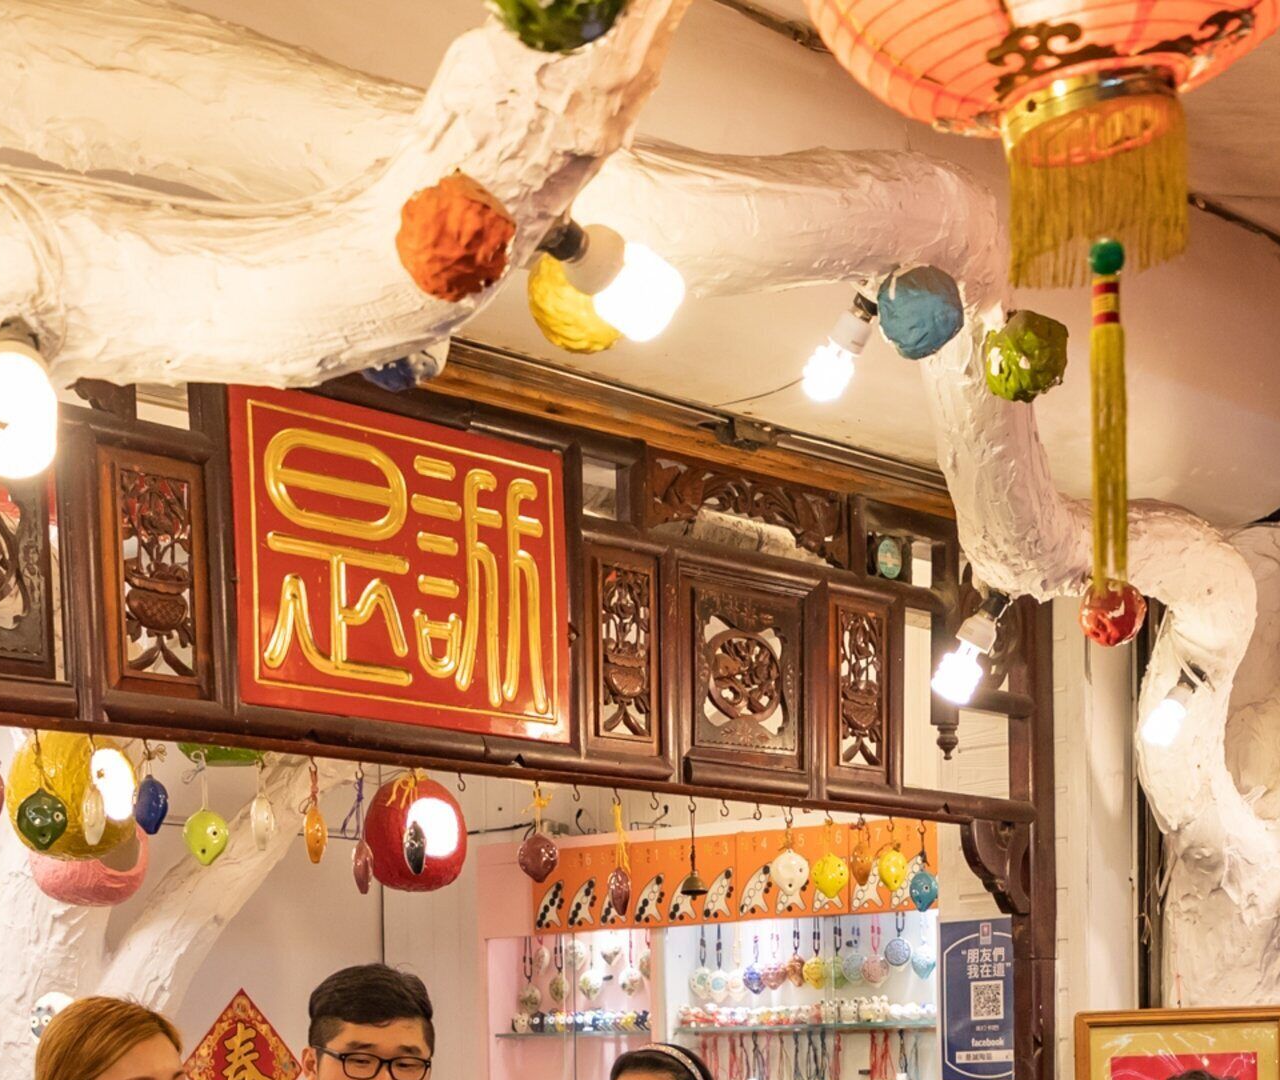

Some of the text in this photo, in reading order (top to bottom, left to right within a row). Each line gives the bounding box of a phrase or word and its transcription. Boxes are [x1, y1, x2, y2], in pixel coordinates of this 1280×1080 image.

[760, 837, 767, 849] 4
[797, 833, 805, 846] 5
[834, 831, 842, 844] 6
[875, 828, 882, 841] 7
[971, 1037, 1005, 1048] facebook
